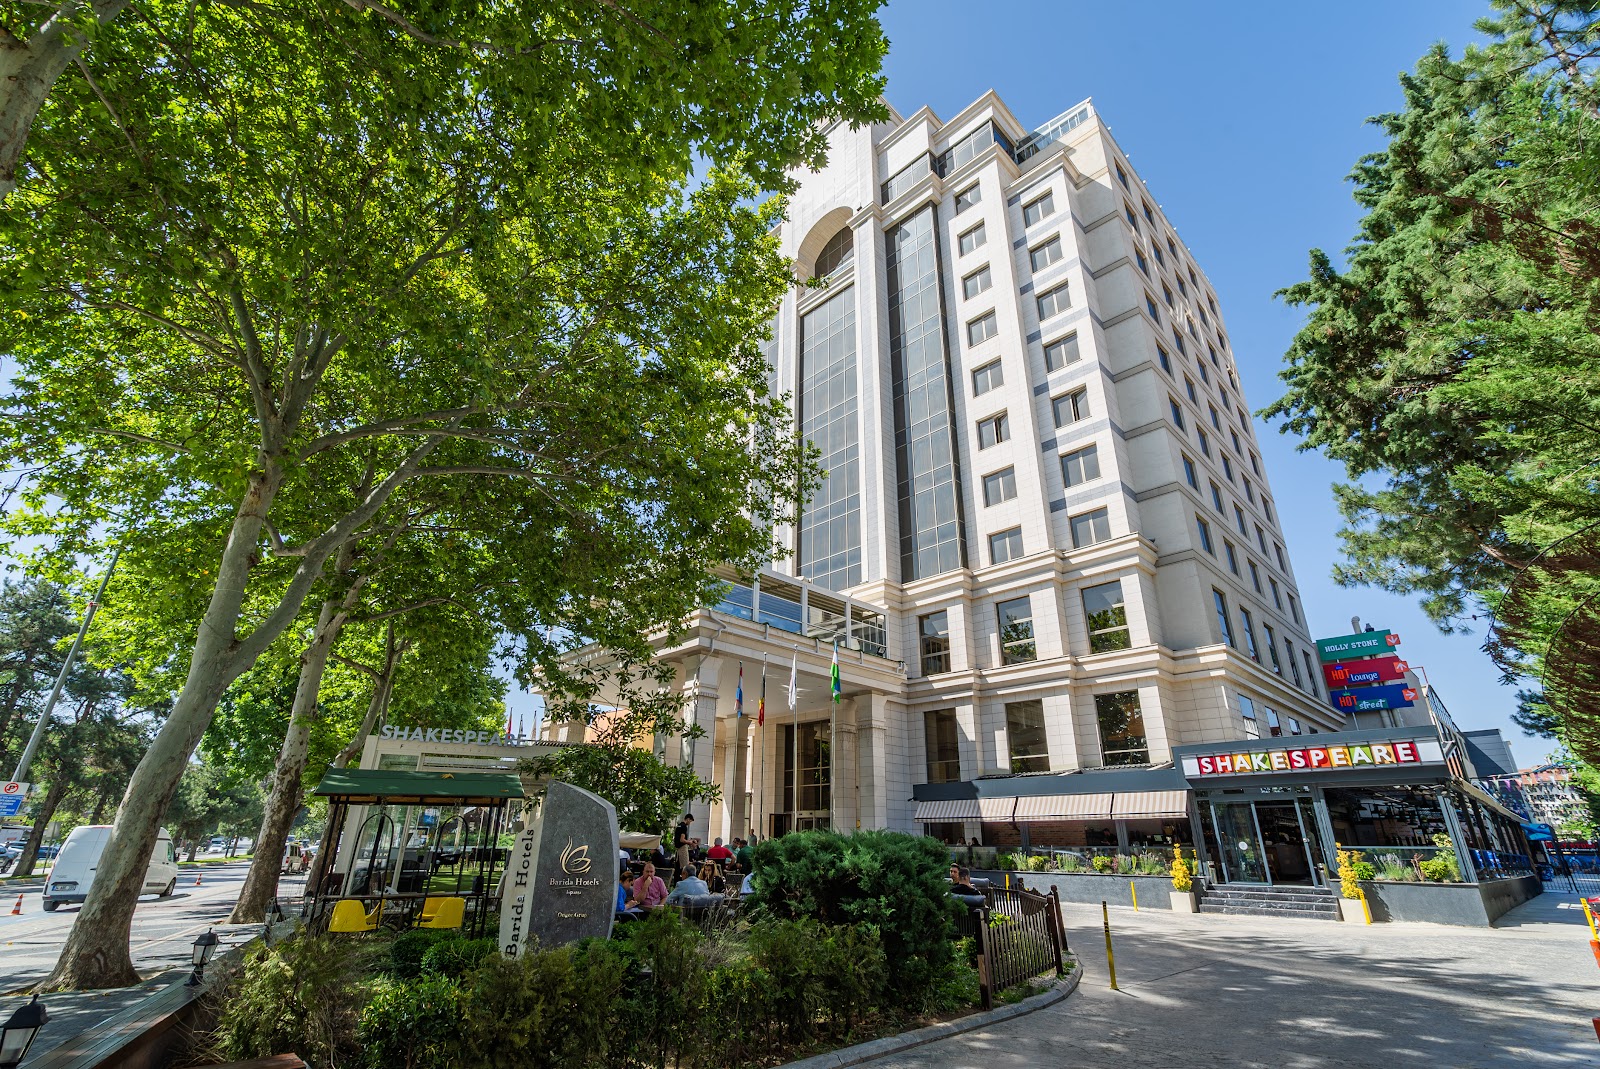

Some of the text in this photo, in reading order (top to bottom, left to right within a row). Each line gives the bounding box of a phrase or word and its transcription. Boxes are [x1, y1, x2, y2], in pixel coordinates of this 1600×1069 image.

[1351, 640, 1379, 649] STONE
[1331, 668, 1350, 680] HOT
[1339, 695, 1386, 710] HOT street
[380, 724, 527, 748] SHAKESPEARE
[1200, 743, 1415, 774] SHAKESPEARE
[549, 877, 600, 886] Barida Hotels
[505, 829, 535, 960] Barida Hotels
